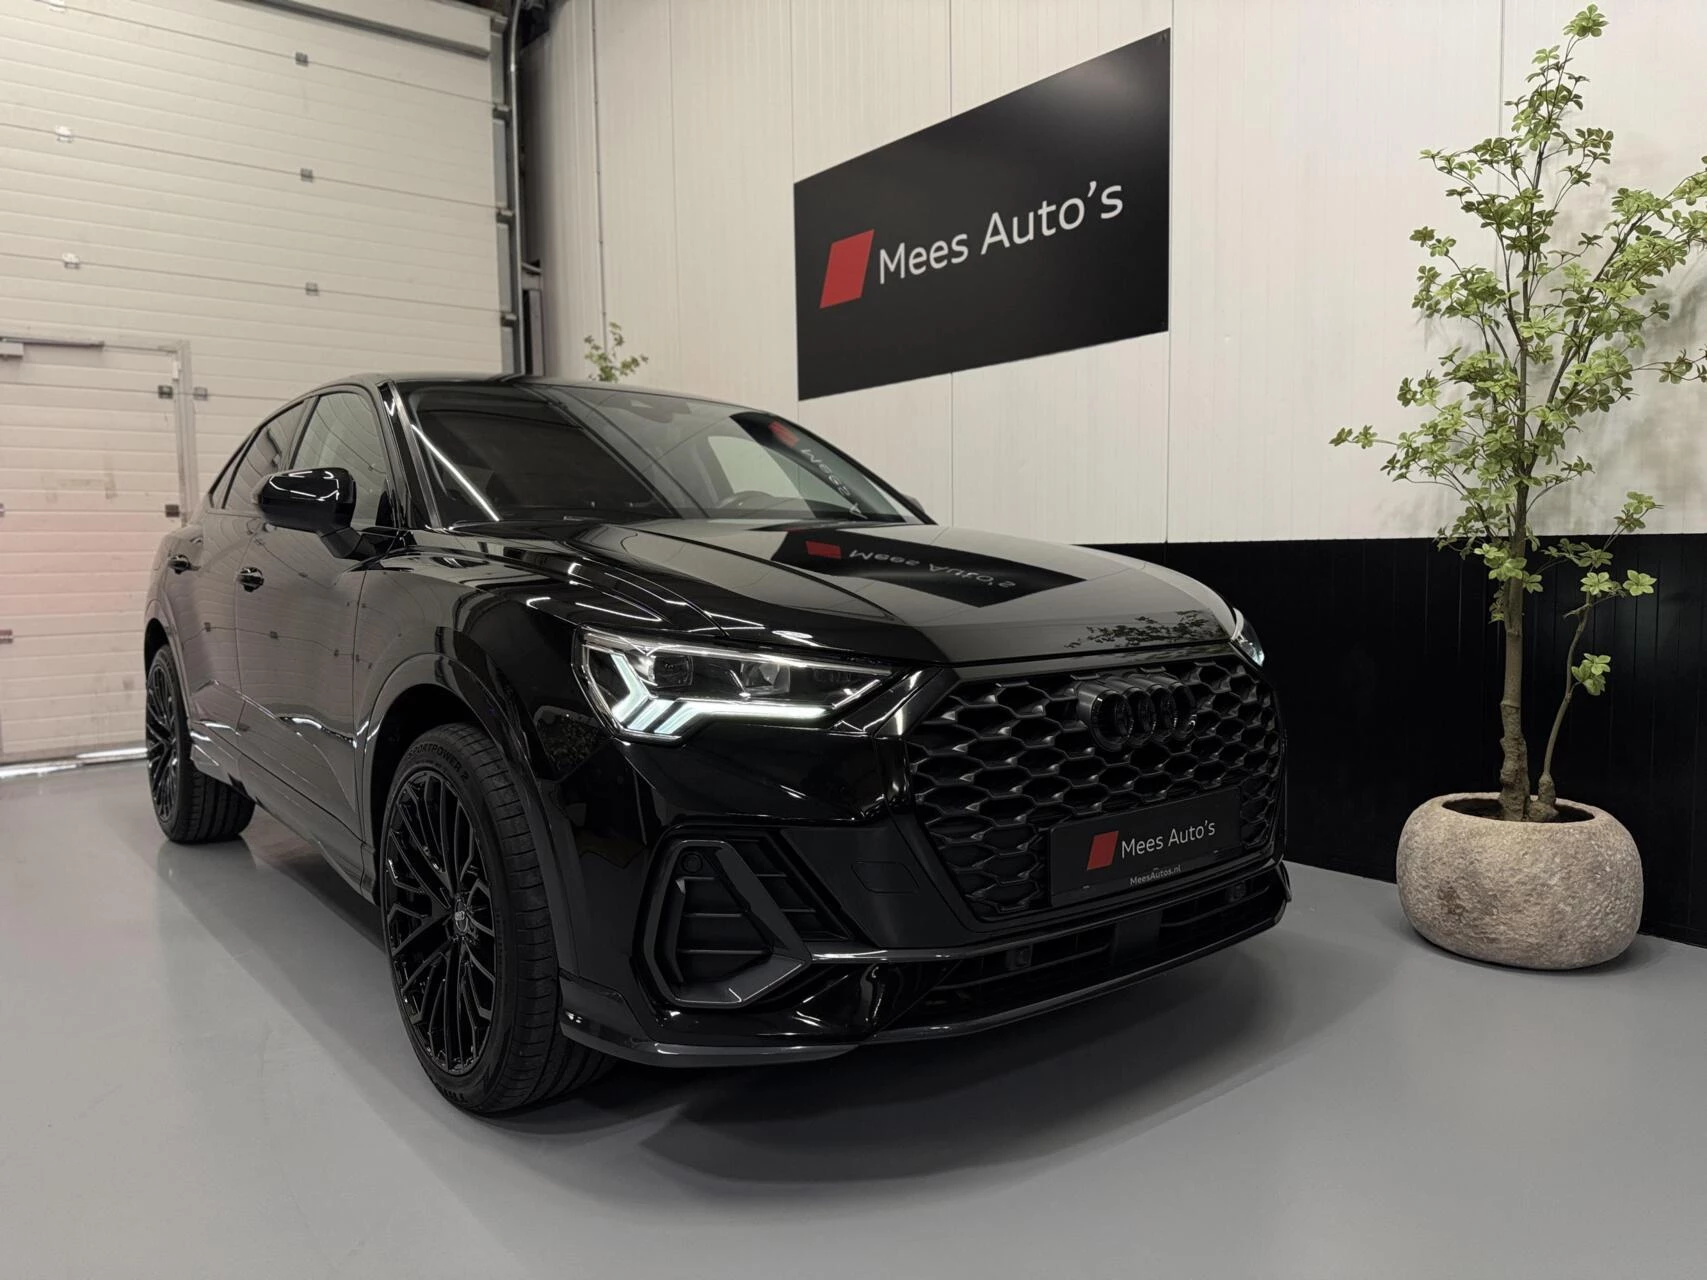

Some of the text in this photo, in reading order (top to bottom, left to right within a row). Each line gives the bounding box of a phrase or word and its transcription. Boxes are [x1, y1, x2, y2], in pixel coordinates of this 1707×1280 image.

[879, 181, 1124, 285] Mees Auto's
[1121, 819, 1216, 859] Mees Auto's
[1129, 865, 1181, 887] MeesAutos.nl
